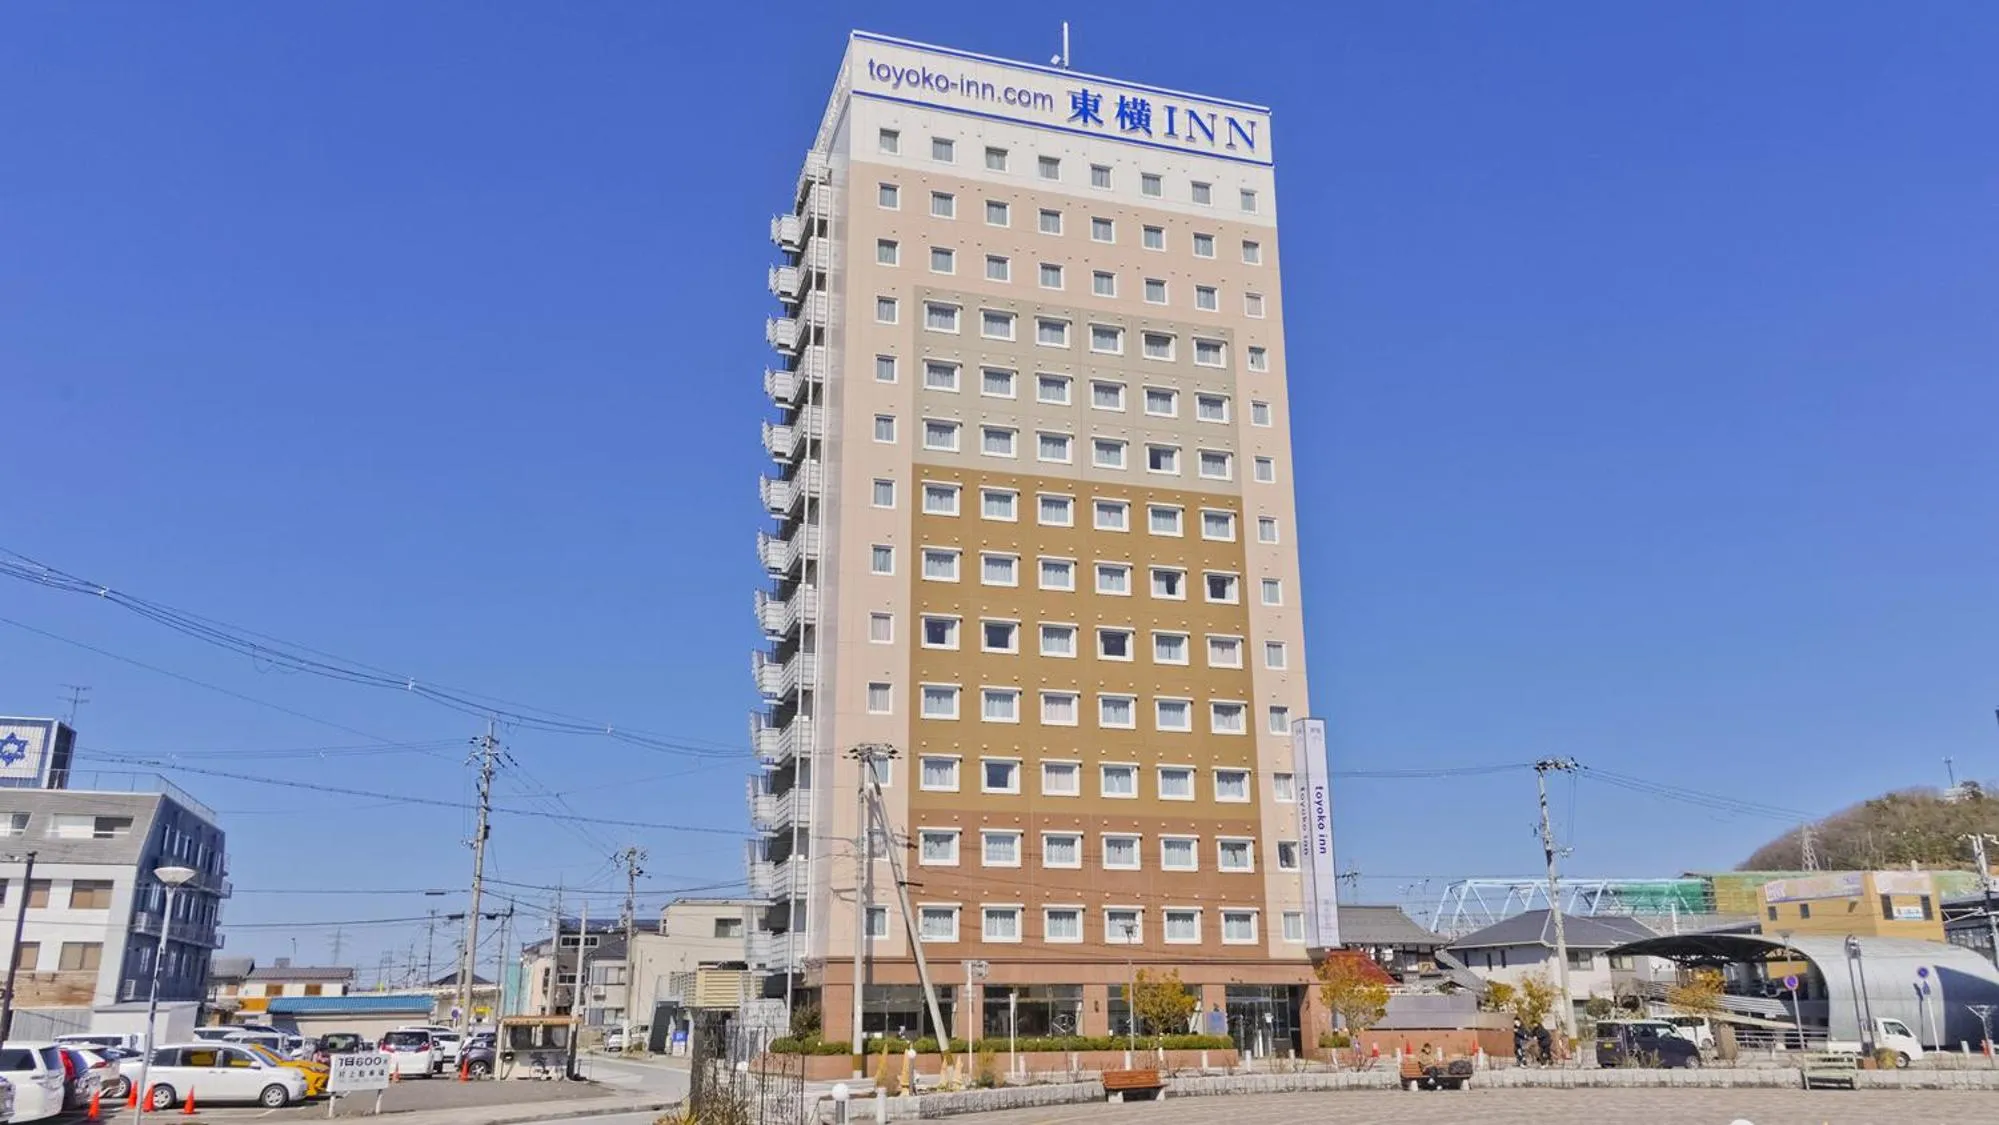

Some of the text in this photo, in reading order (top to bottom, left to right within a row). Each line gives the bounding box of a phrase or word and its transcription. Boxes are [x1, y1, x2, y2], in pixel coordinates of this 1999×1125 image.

[868, 58, 1054, 112] toyoko-inn.com
[1315, 786, 1328, 854] toyoko inn
